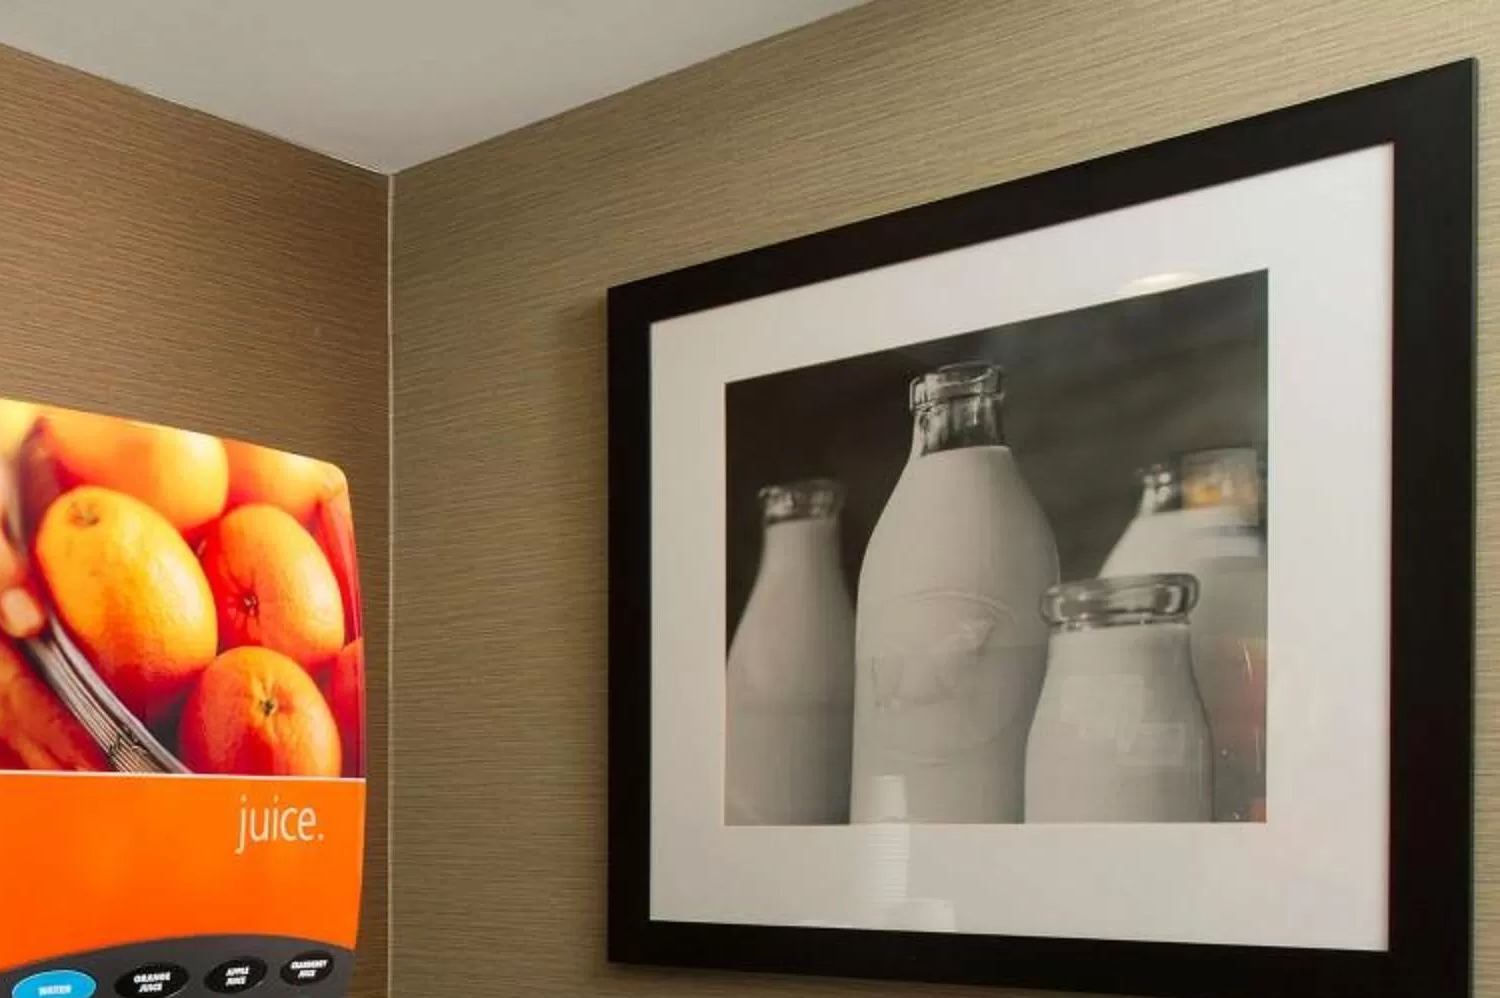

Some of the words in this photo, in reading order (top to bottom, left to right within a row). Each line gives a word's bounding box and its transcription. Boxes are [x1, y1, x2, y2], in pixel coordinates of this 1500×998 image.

[234, 795, 325, 855] juice.
[133, 971, 171, 984] ORANGE
[138, 983, 163, 993] JUICE
